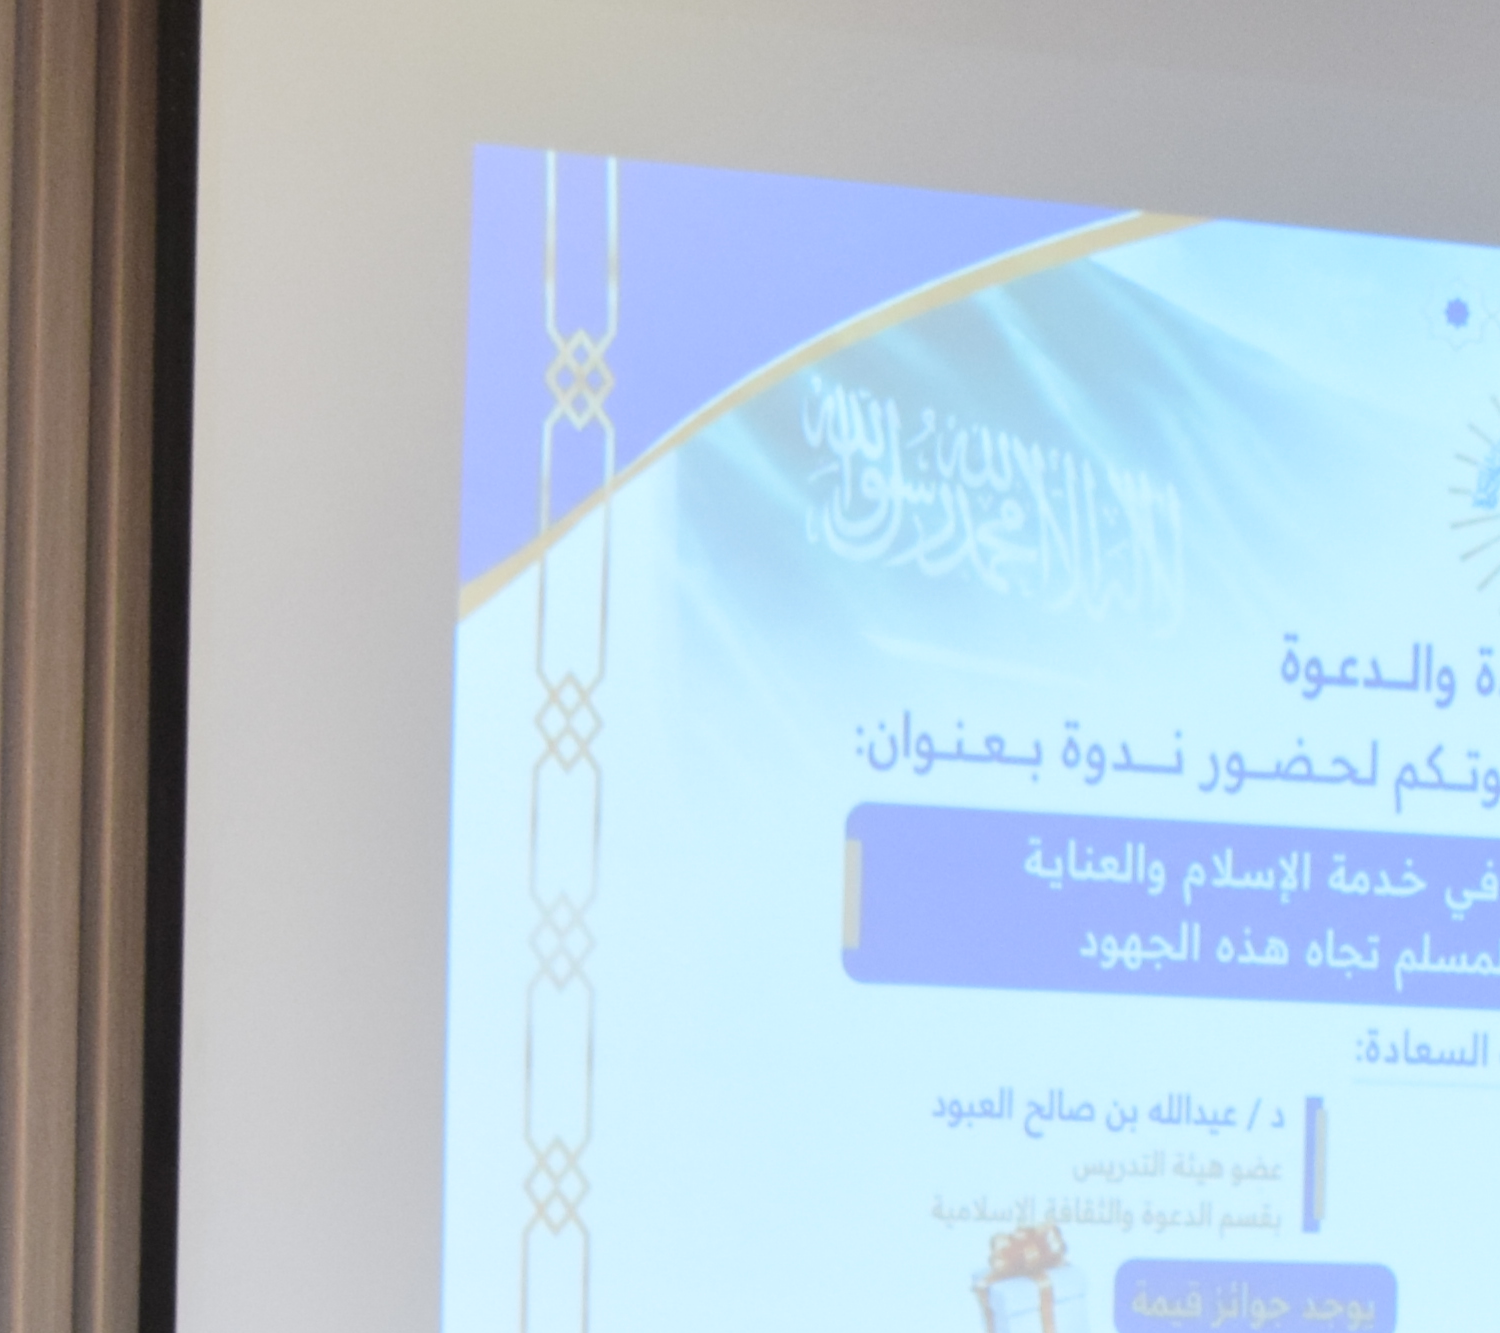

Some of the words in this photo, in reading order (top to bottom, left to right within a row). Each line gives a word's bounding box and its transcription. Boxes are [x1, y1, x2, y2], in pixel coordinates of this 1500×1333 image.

[1281, 633, 1456, 709] والدعوة
[1061, 720, 1184, 786] ندوة
[1198, 738, 1379, 795] لحضور
[1024, 837, 1166, 895] والعناية
[1183, 848, 1311, 905] الإسلام
[1328, 854, 1427, 896] خدمة
[1445, 860, 1499, 920] في
[1080, 922, 1200, 970] الجهود
[1217, 928, 1289, 965] هذه
[1306, 929, 1379, 978] تجاه
[933, 1087, 1013, 1128] العبود
[1024, 1089, 1095, 1139] صالح
[1106, 1101, 1138, 1132] بن
